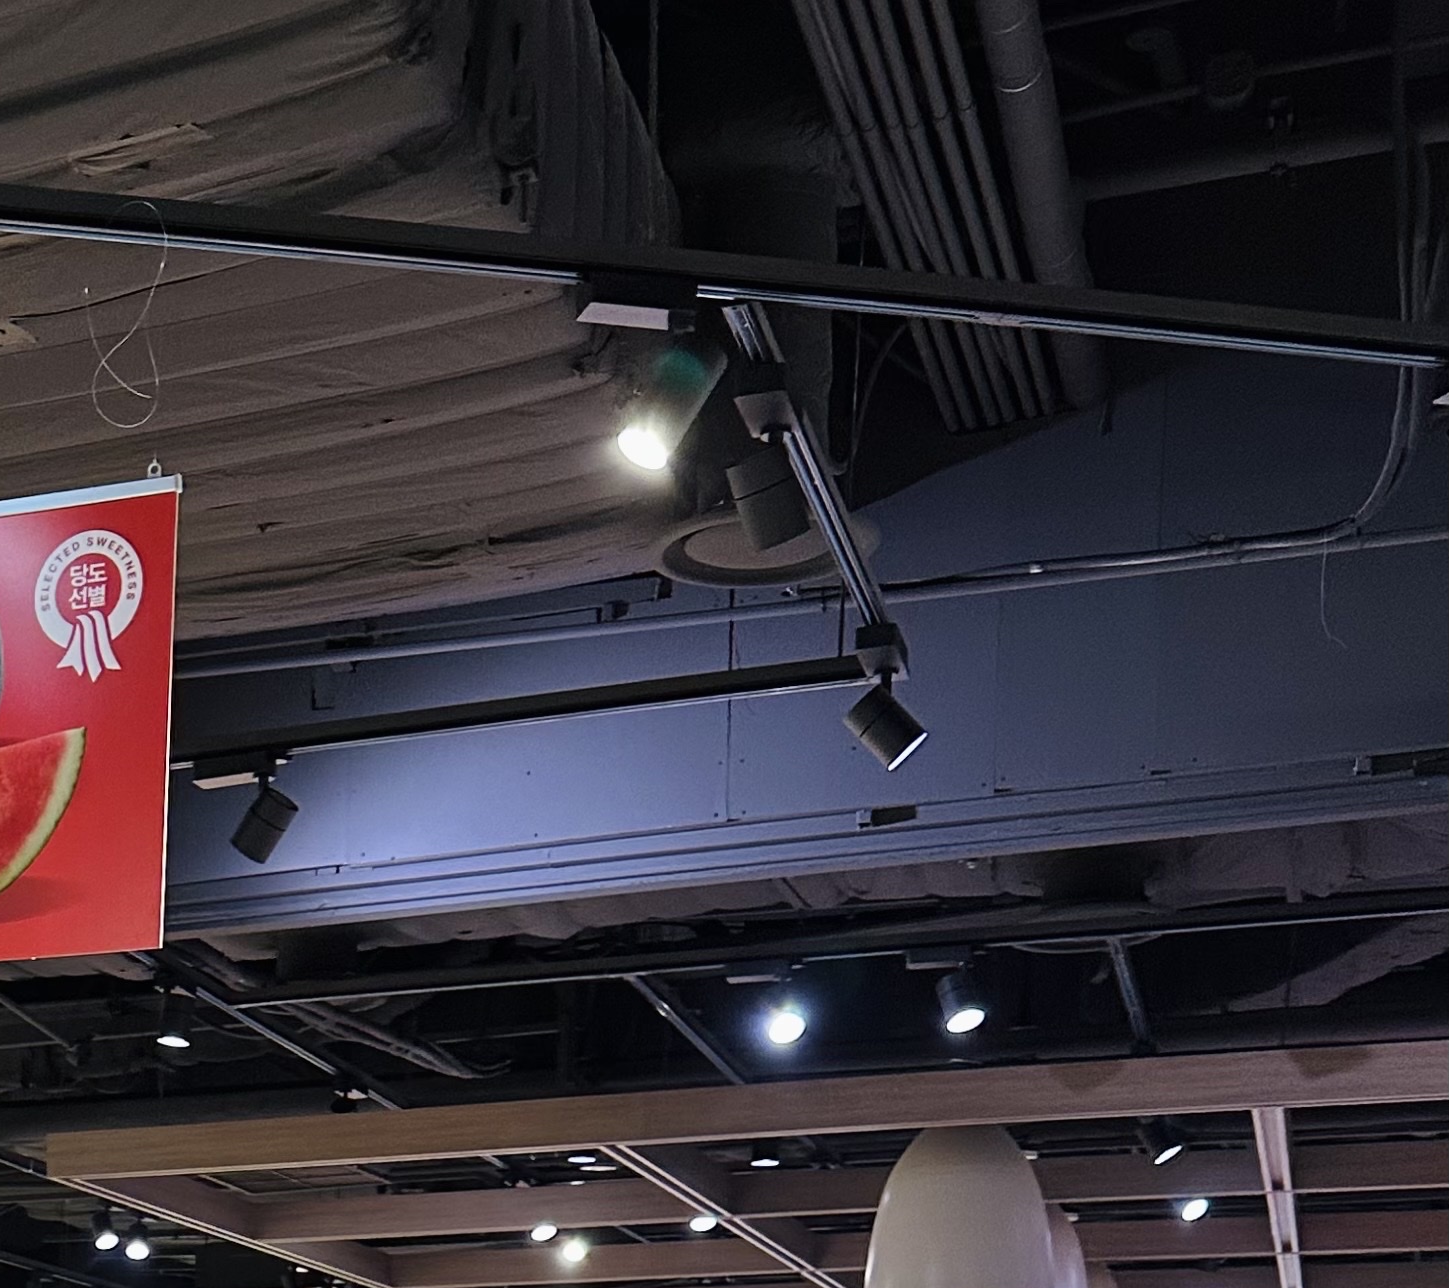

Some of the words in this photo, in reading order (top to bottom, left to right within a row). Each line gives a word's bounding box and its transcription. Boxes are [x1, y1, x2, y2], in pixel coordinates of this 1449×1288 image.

[40, 542, 80, 612] SELECTED
[86, 537, 137, 600] SWEETNESS
[70, 562, 108, 587] 당도
[68, 583, 106, 610] 선별
